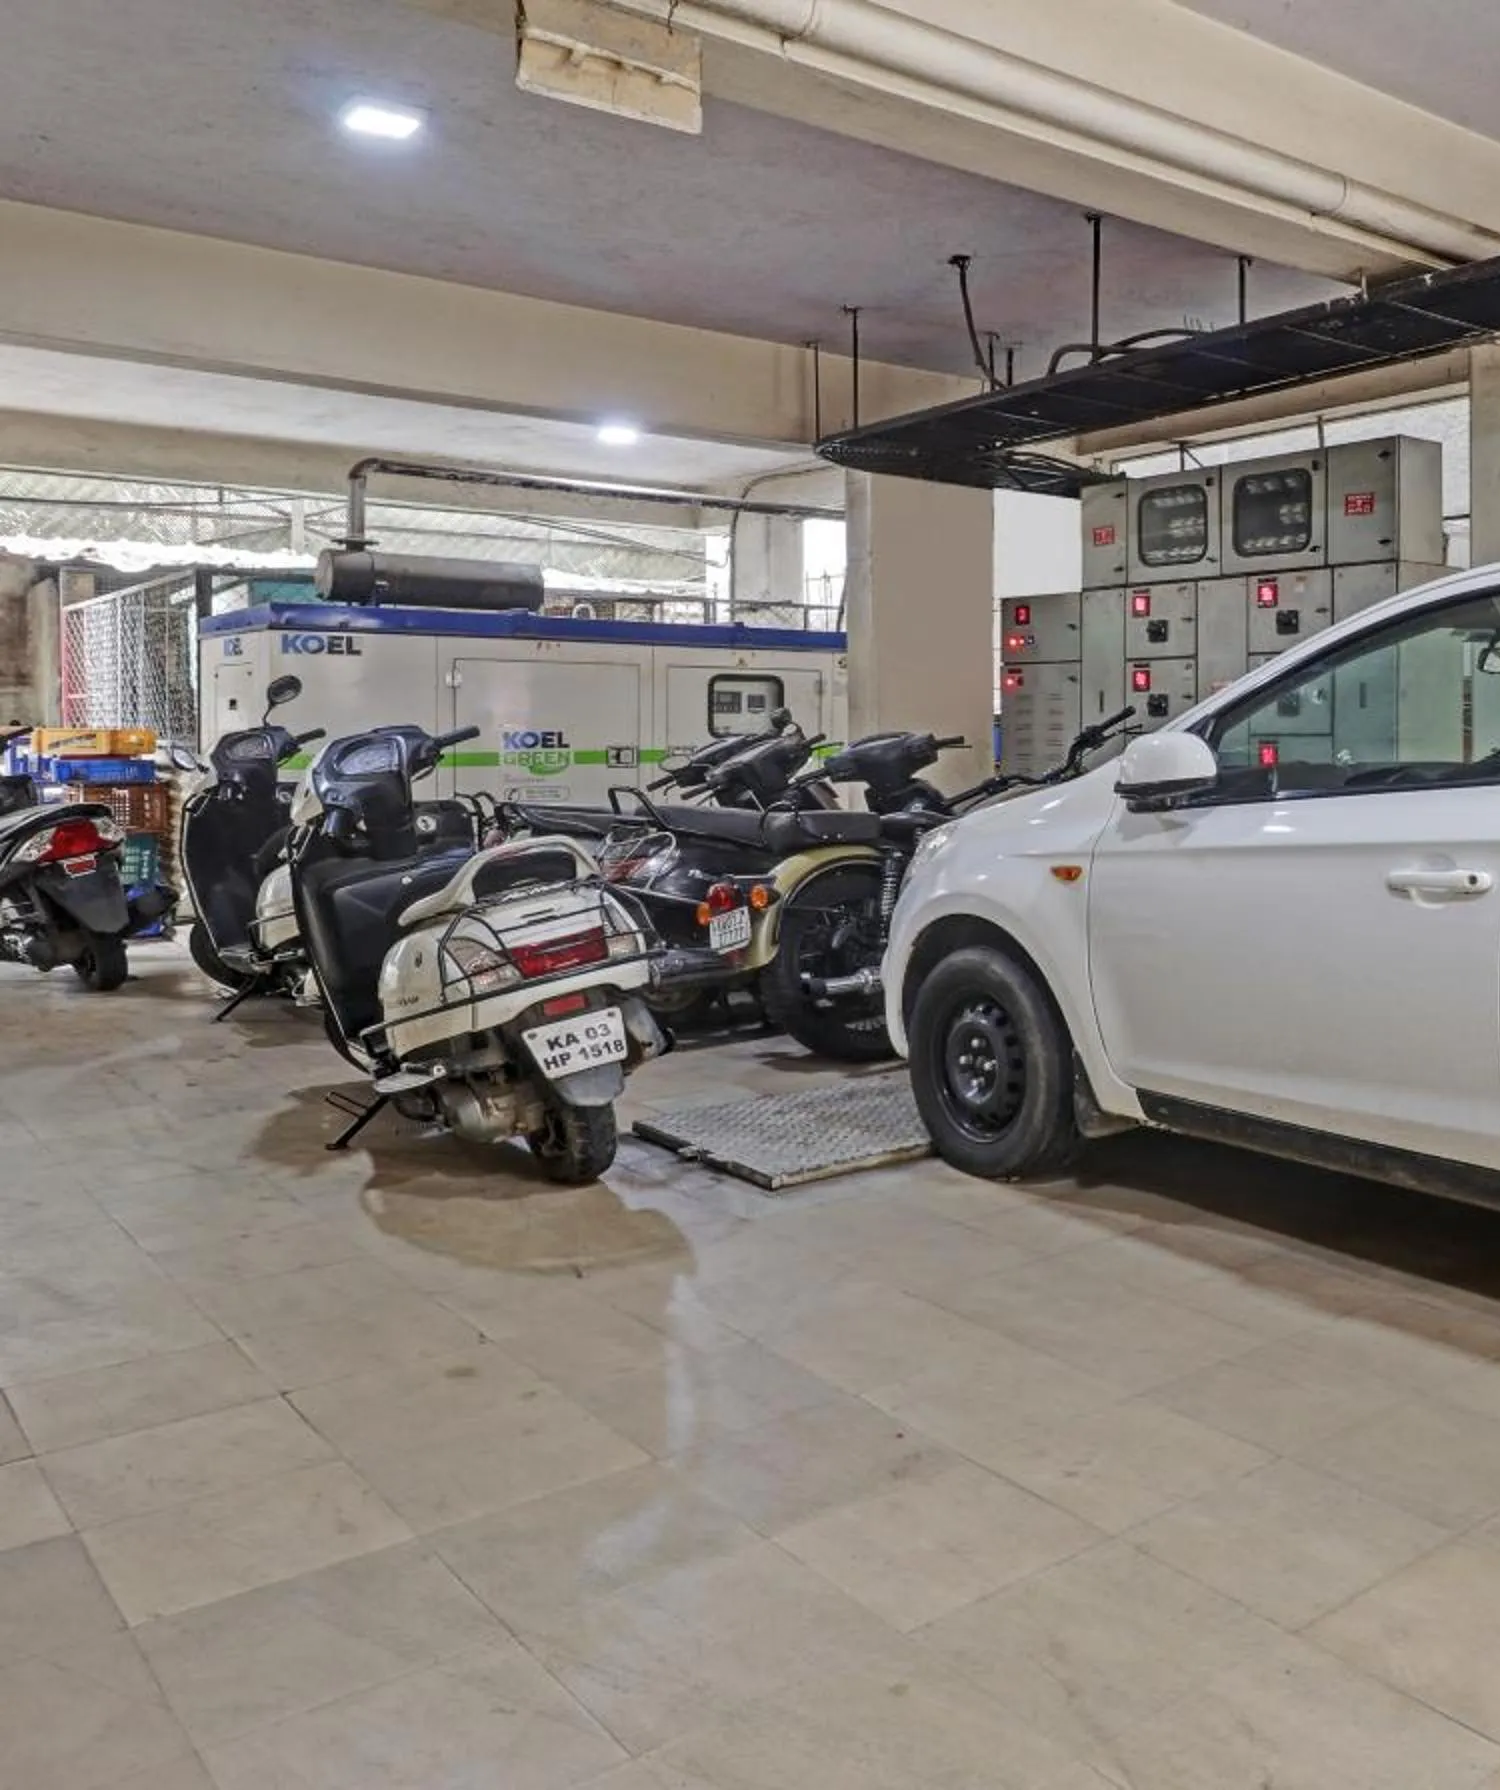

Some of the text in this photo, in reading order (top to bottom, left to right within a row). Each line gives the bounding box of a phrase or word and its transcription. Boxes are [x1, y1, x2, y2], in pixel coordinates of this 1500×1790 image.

[281, 633, 362, 656] KOEL
[503, 731, 570, 749] KOEL
[503, 752, 570, 766] GREEN
[546, 1023, 612, 1051] KA 03
[543, 1039, 625, 1071] HP 1518
